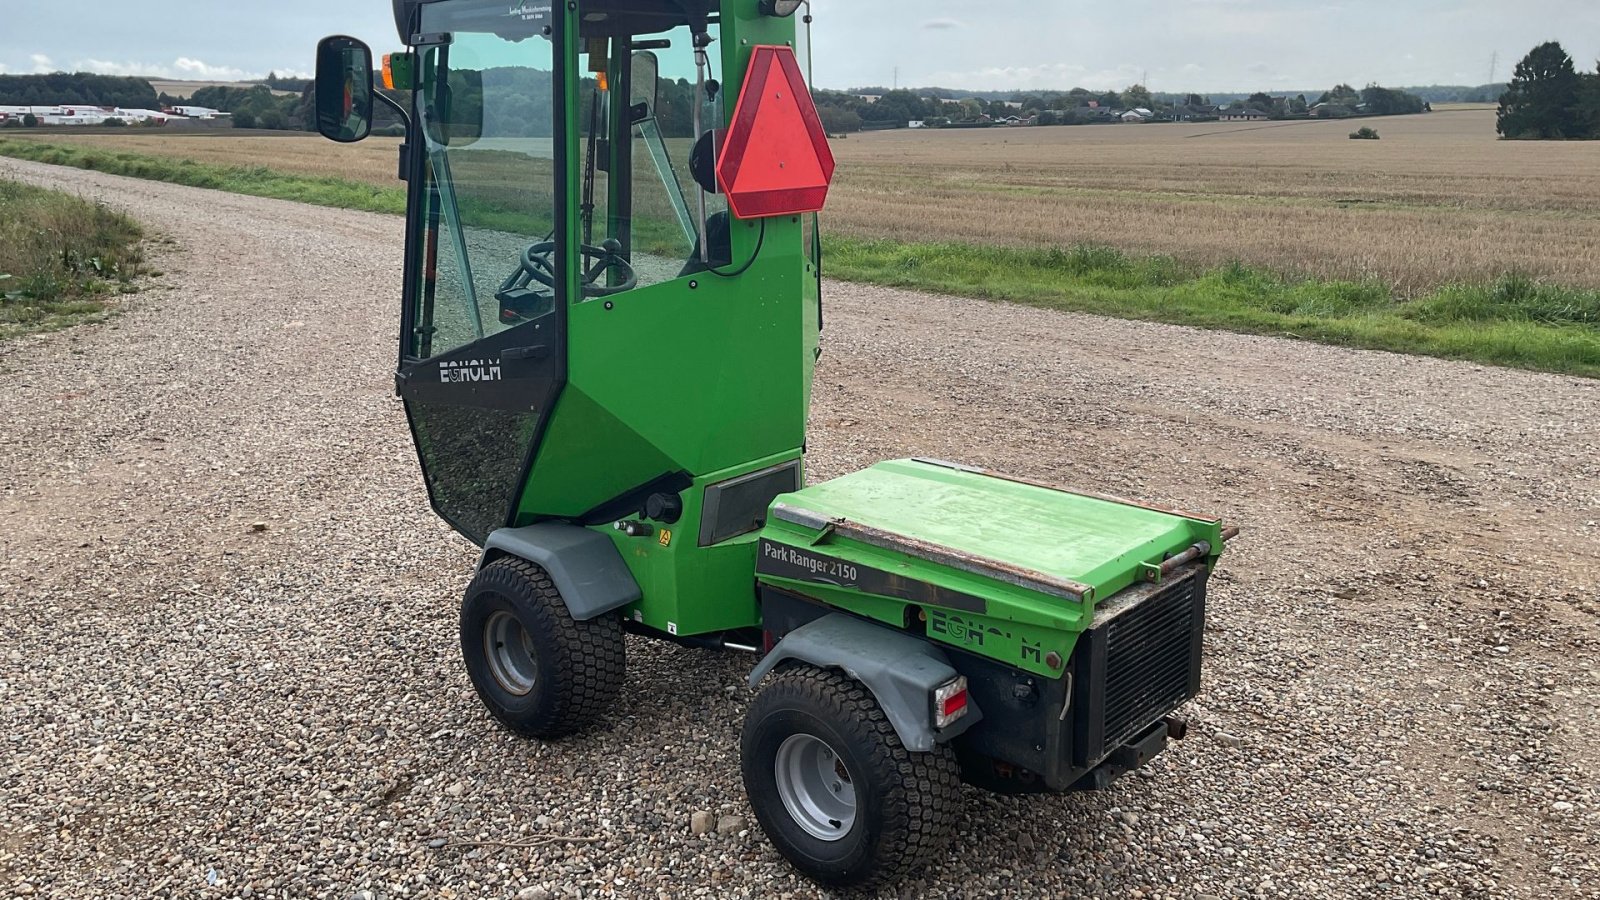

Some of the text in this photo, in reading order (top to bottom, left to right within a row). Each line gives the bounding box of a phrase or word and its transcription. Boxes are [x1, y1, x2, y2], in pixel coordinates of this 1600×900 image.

[439, 358, 501, 383] EGHOLM
[764, 542, 857, 581] Park Ranger 2150
